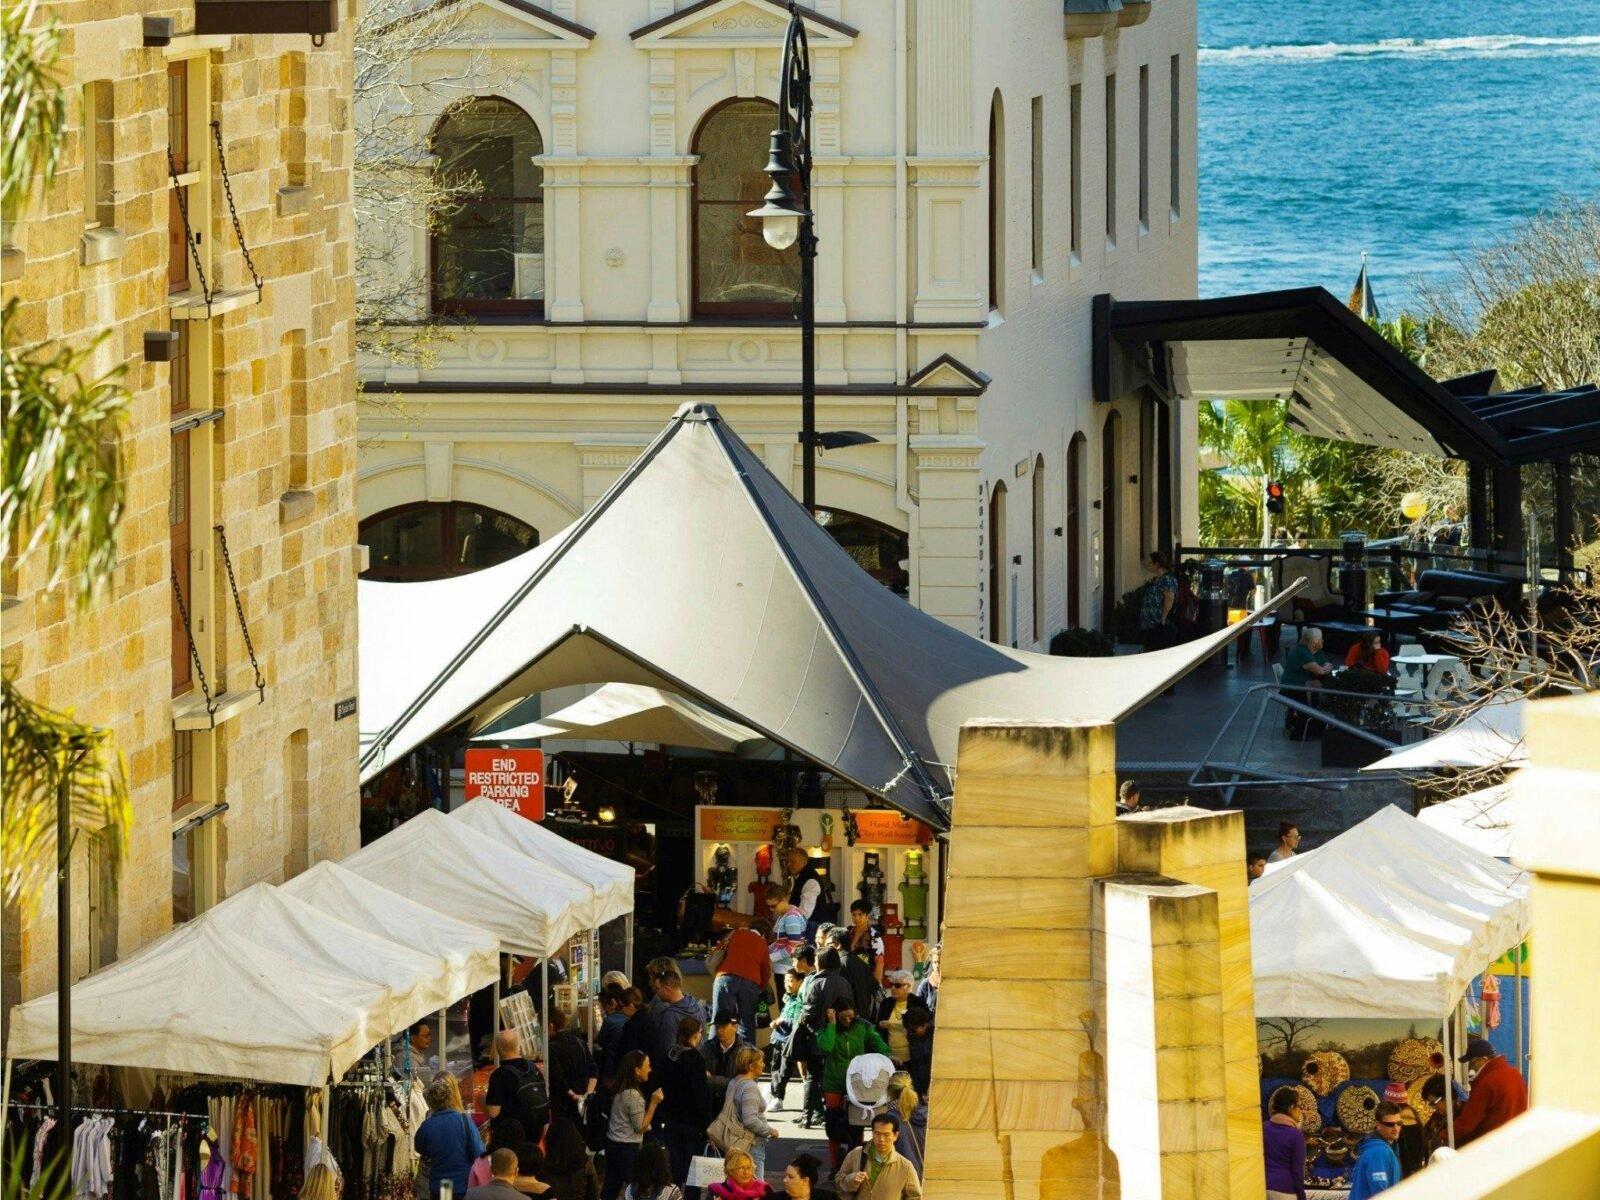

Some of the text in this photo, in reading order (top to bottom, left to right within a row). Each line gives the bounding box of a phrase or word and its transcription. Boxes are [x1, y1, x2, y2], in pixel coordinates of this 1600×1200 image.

[492, 759, 517, 772] END
[469, 772, 540, 785] RESTRICTED
[480, 785, 529, 798] PARKING
[493, 798, 521, 812] REA
[736, 825, 768, 835] Gallery
